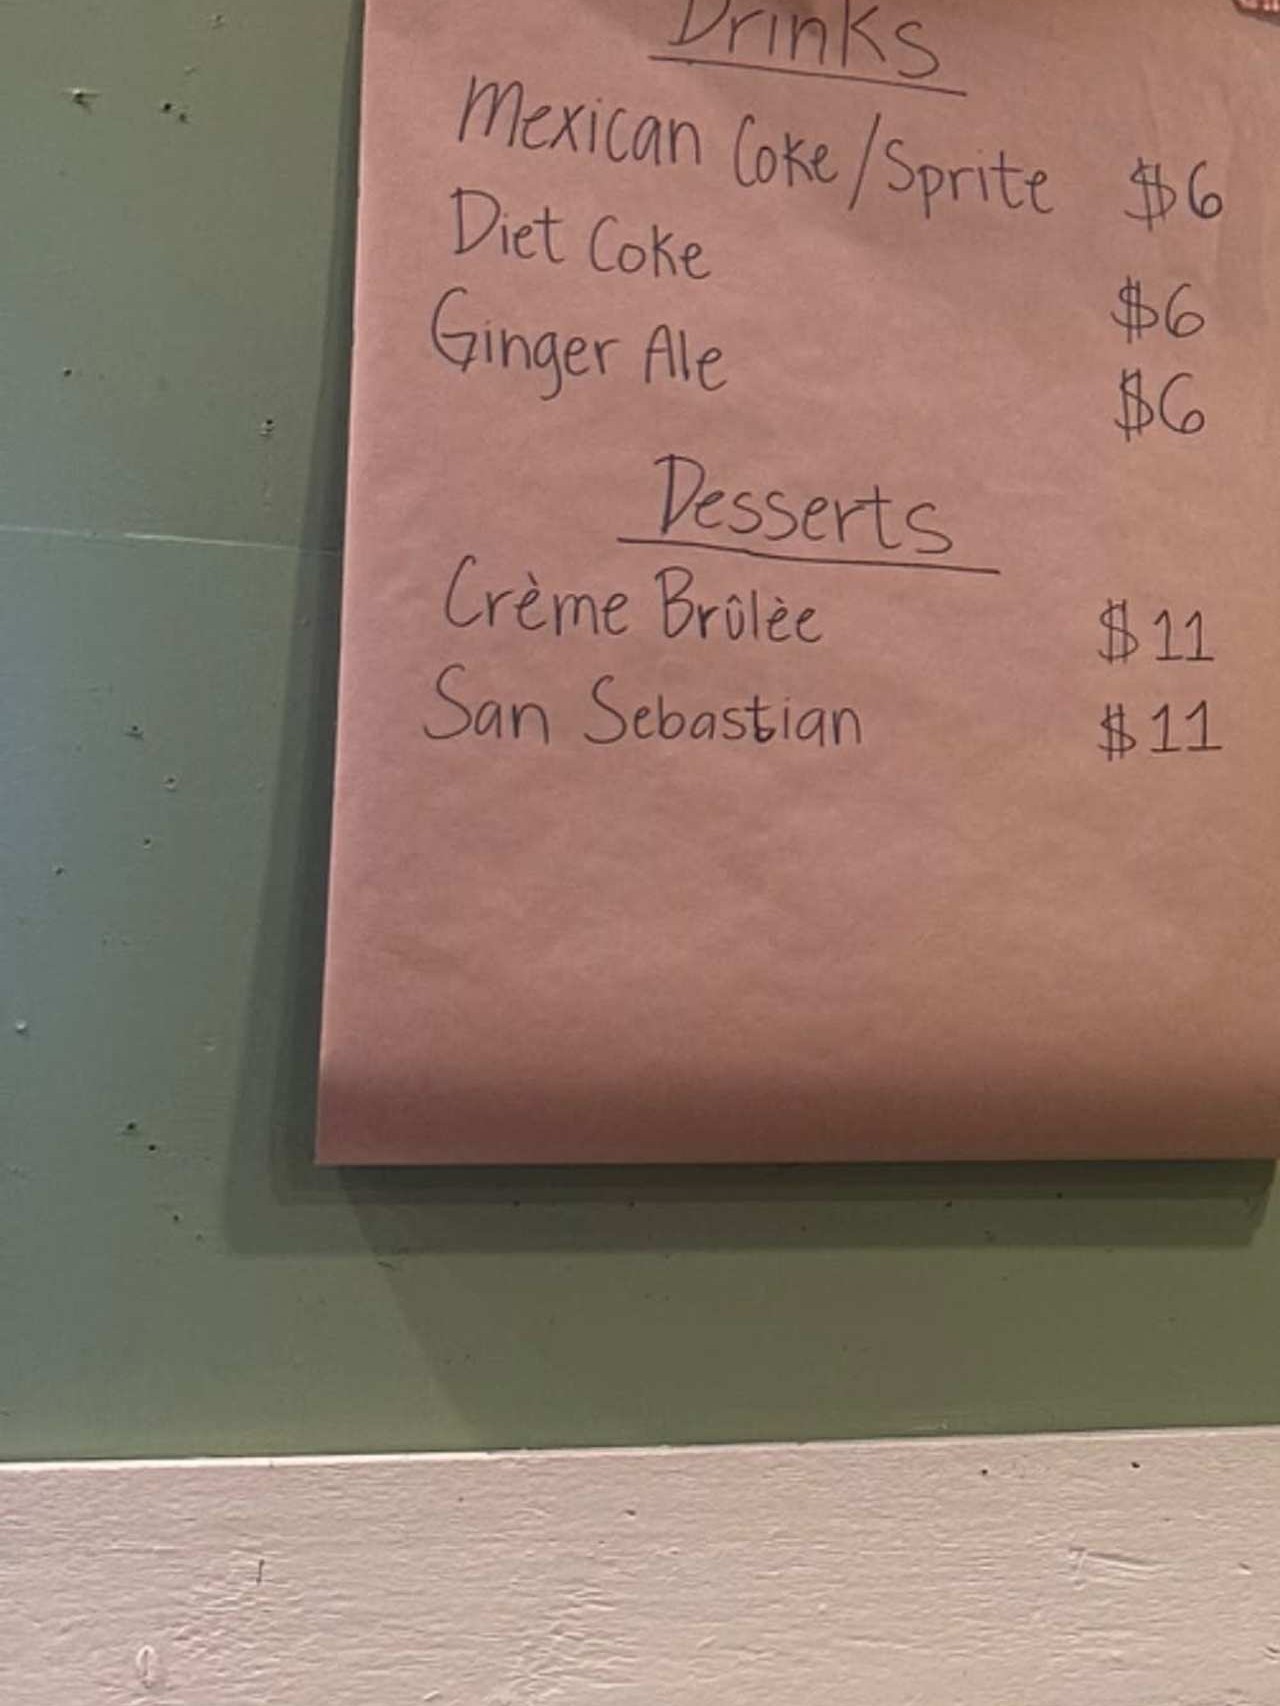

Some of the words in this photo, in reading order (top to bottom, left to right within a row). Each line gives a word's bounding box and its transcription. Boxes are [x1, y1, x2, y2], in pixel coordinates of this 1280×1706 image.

[458, 76, 701, 166] Mexican
[1124, 157, 1223, 231] $6
[450, 187, 565, 264] Diet
[1111, 275, 1205, 344] $6
[431, 287, 620, 401] Ginger
[645, 324, 727, 391] Ale
[1114, 369, 1205, 442] $6
[654, 454, 952, 555] Desserts
[445, 555, 629, 636] Crème
[1098, 599, 1214, 664] $11
[424, 664, 549, 745] San
[584, 675, 861, 748] Sebastian
[1098, 700, 1223, 761] $11
